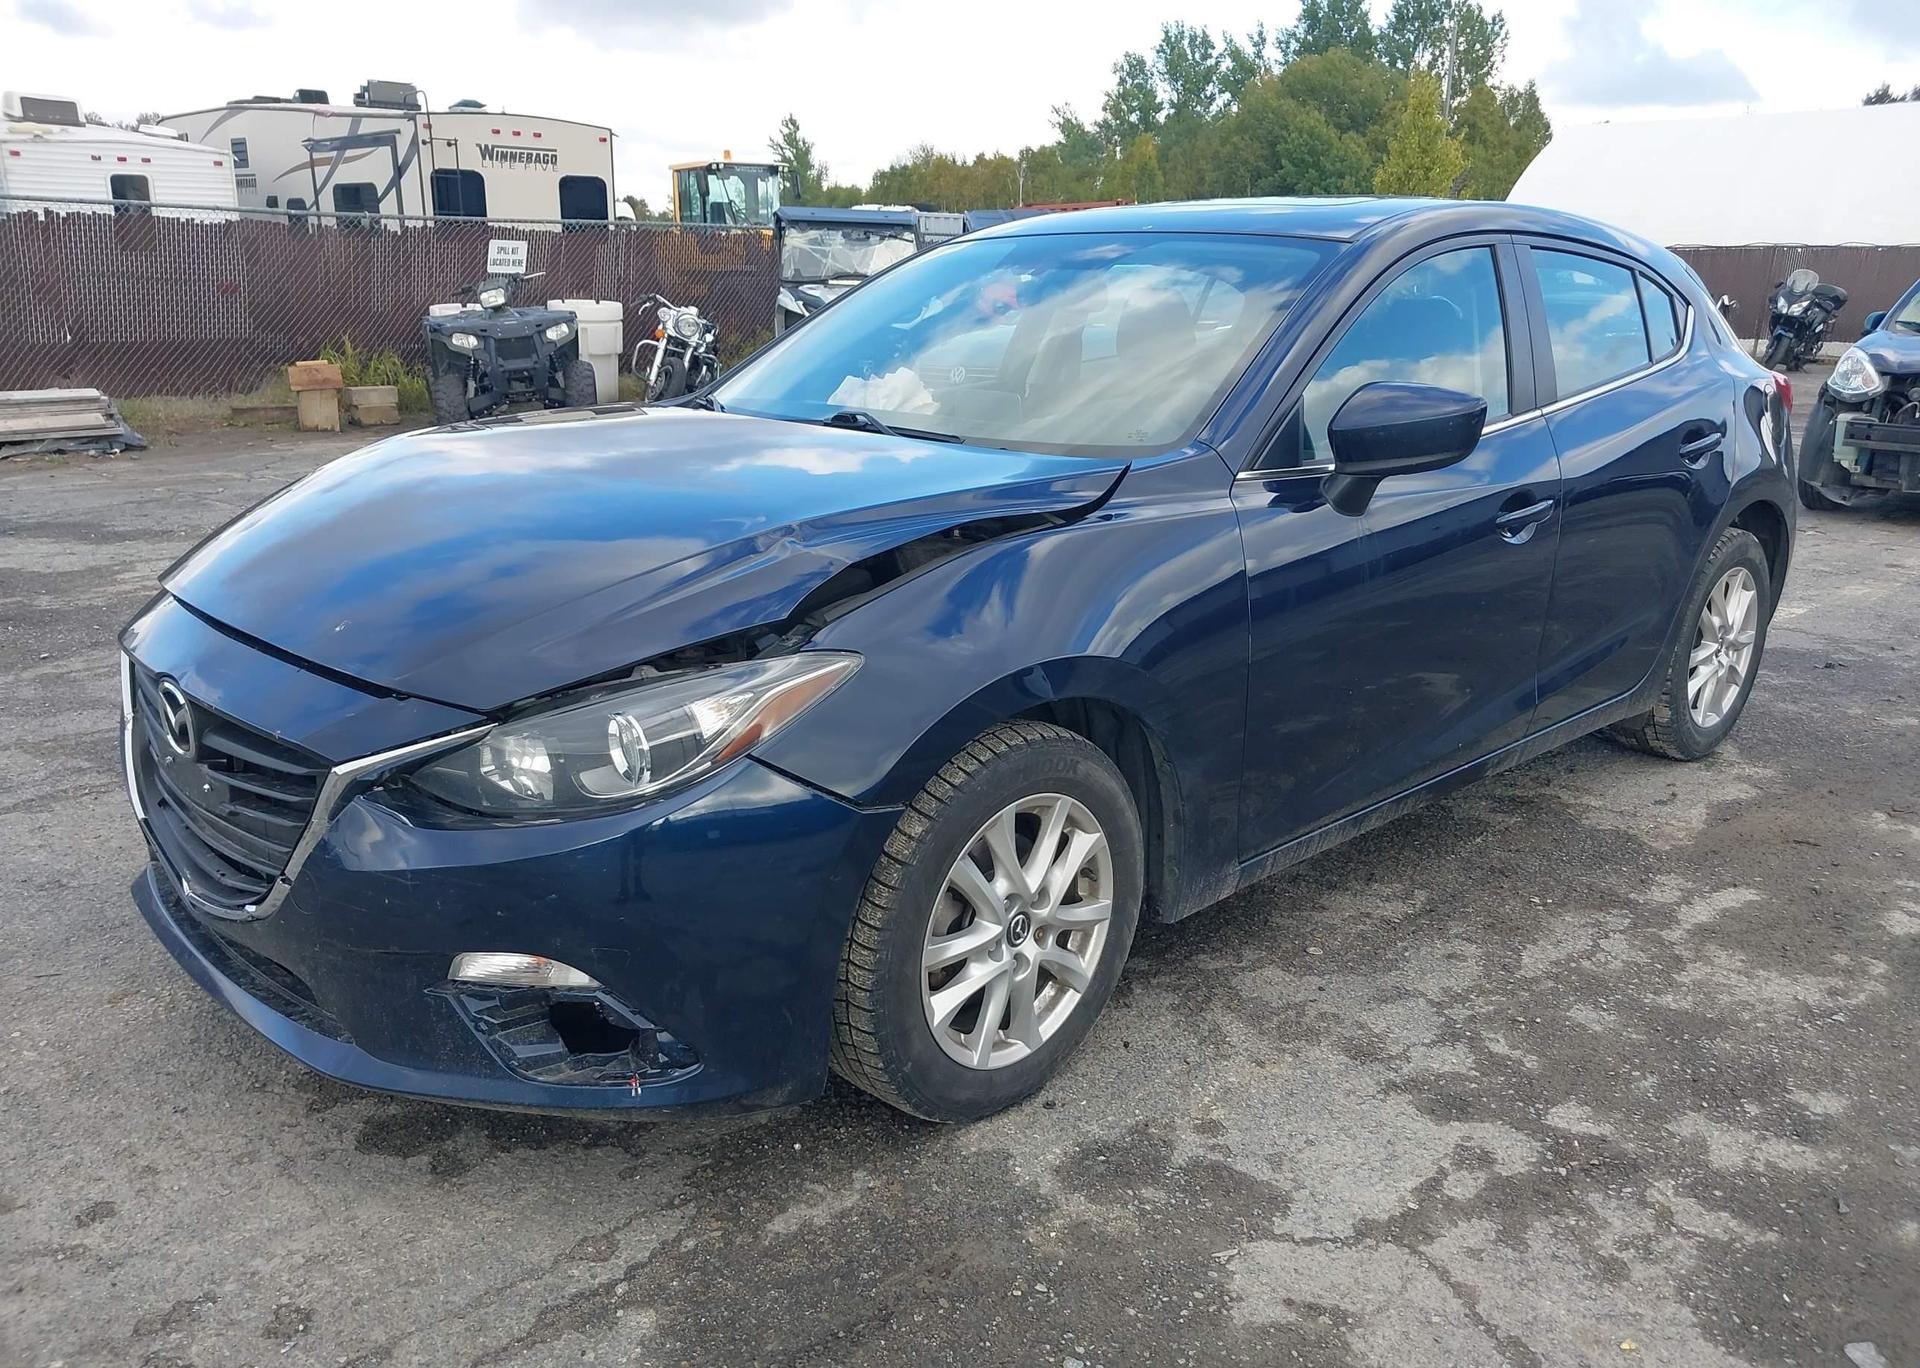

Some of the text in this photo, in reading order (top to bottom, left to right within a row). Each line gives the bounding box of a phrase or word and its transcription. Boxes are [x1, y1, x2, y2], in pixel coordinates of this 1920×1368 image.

[475, 143, 558, 166] WINNEBAGO
[496, 245, 520, 255] SPILL KIT
[489, 257, 525, 267] LOCATED HERE
